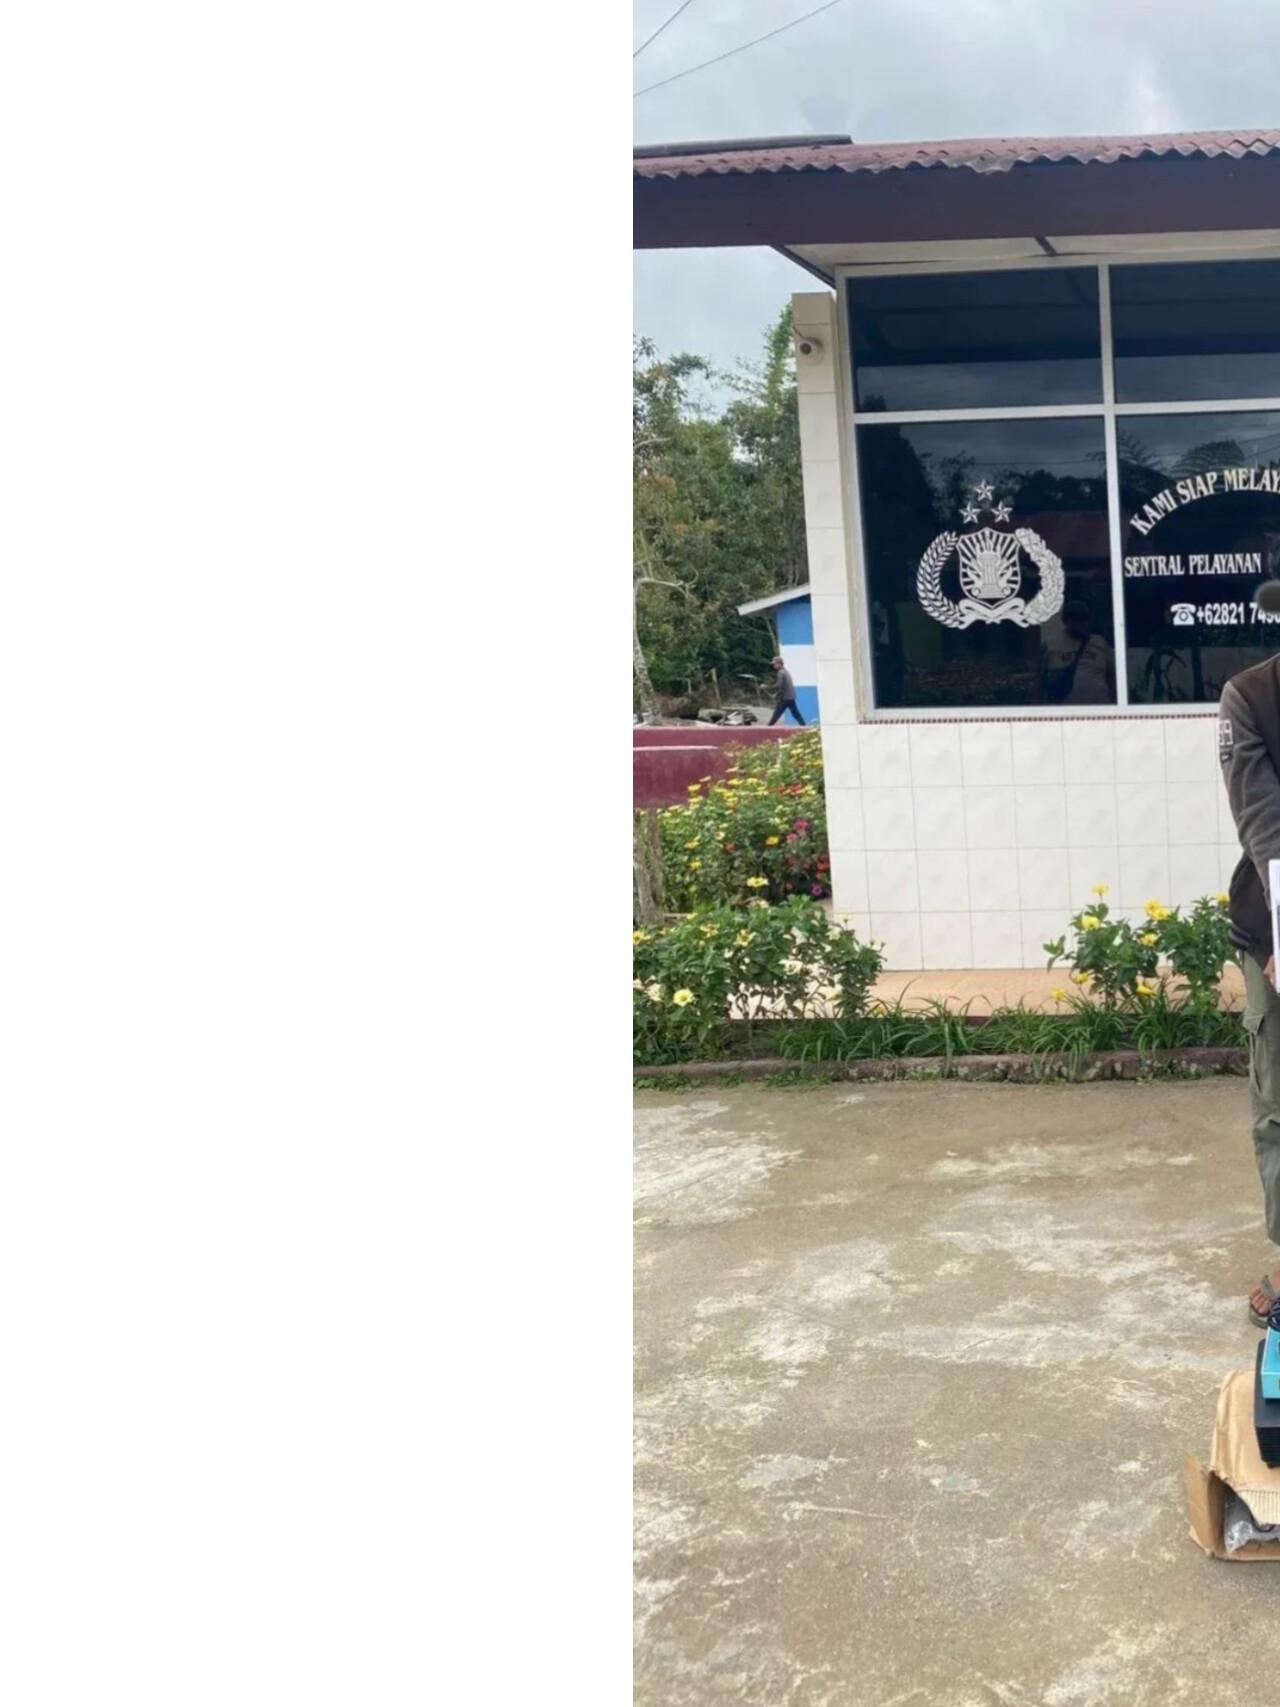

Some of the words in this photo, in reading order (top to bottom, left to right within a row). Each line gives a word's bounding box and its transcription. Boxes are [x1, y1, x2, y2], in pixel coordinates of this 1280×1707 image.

[1130, 487, 1178, 536] KAMI
[1176, 470, 1218, 504] SIAP
[1124, 556, 1185, 578] SENTRAL
[1189, 552, 1262, 576] PELAYANAN
[1196, 602, 1245, 626] +62821
